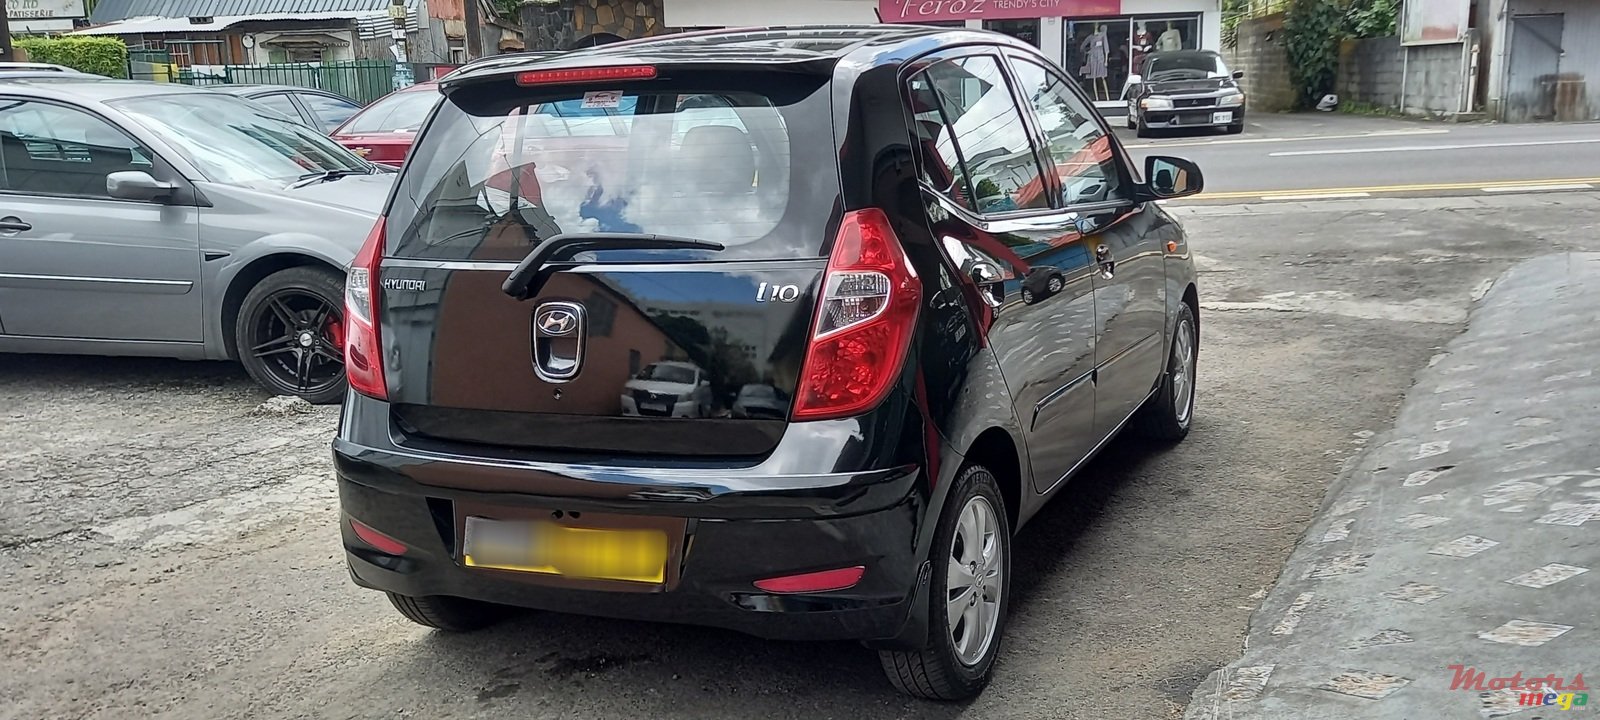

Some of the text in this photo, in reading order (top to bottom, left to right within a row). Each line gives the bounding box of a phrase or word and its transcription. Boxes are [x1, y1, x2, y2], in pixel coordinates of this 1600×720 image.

[993, 0, 1061, 9] TRENDY'S CITY
[9, 9, 54, 17] PATISSERIE
[384, 278, 426, 291] HYUNDAI
